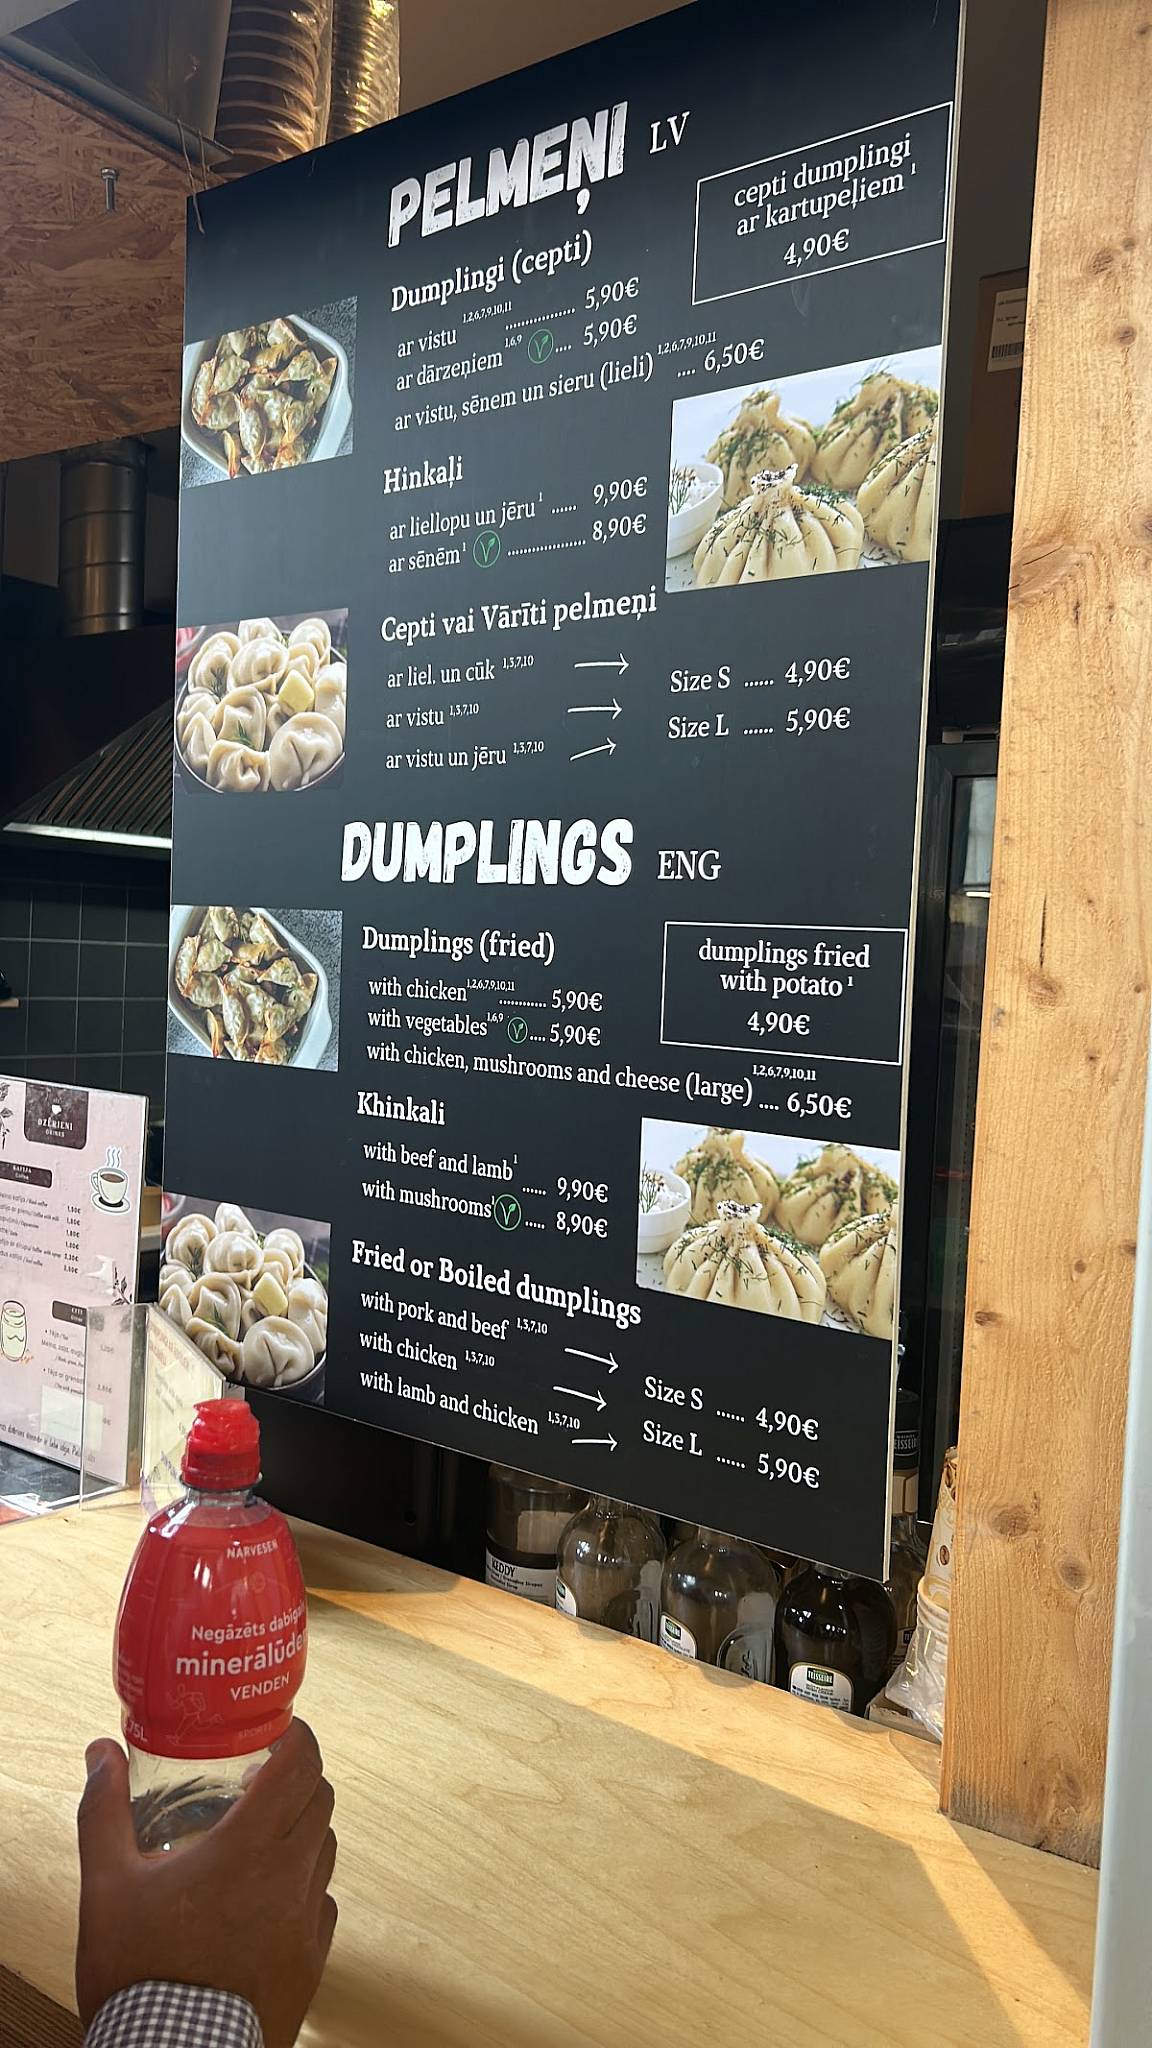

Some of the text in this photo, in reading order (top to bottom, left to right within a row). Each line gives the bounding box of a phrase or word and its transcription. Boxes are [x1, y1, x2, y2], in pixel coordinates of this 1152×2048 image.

[650, 112, 689, 153] LV
[387, 101, 627, 248] PELMEŅI
[735, 133, 911, 207] cepti dumplingi
[737, 215, 759, 235] ar
[765, 172, 905, 228] kartupeļiem
[784, 229, 851, 268] 4,90€
[392, 230, 591, 313] Dumplingi (cepti)
[398, 341, 414, 357] ar
[419, 330, 456, 351] vistu
[585, 277, 638, 311] 5,90€
[397, 374, 413, 390] ar
[417, 353, 502, 385] dārzeņiem
[584, 315, 637, 347] 5,90€
[395, 414, 411, 430] ar
[416, 405, 457, 425] vistu,
[462, 391, 516, 416] sēnem
[523, 385, 543, 402] un
[549, 373, 594, 396] sieru
[601, 352, 653, 390] (lieli)
[705, 339, 764, 373] 6,50€
[384, 456, 462, 494] Hinkaļi
[390, 524, 406, 540] ar
[410, 512, 470, 536] liellopu
[476, 510, 496, 524] un
[500, 501, 535, 528] jēru
[594, 477, 647, 505] 9,90€
[389, 558, 405, 572] ar
[409, 548, 460, 570] sēnēm
[593, 514, 646, 544] 8,90€
[382, 585, 656, 646] Cepti vai Vārīti pelmeņi
[388, 673, 403, 687] ar
[408, 664, 435, 686] liel.
[441, 669, 460, 683] un
[466, 659, 494, 681] cūk
[671, 658, 850, 692] Size S 4,90€
[387, 714, 402, 728] ar
[407, 708, 444, 726] vistu
[669, 707, 850, 738] Size L 5,90€
[386, 755, 402, 768] ar
[406, 749, 443, 767] vistu
[449, 752, 468, 766] un
[472, 746, 506, 771] jēru
[341, 819, 633, 885] DUMPLINGS
[658, 850, 721, 880] ENG
[363, 927, 554, 966] Dumplings (fried)
[699, 938, 870, 971] dumplings fried
[369, 977, 402, 996] with
[407, 978, 467, 1001] chicken
[552, 989, 602, 1012] 5,90€
[720, 969, 767, 991] with
[772, 976, 842, 999] potato
[368, 1008, 401, 1027] with
[406, 1014, 487, 1036] vegetables
[550, 1023, 600, 1046] 5,90€
[748, 1012, 810, 1035] 4,90€
[367, 1042, 400, 1062] with
[404, 1045, 468, 1073] chicken,
[473, 1054, 572, 1080] mushrooms
[577, 1064, 610, 1084] and
[616, 1068, 680, 1092] cheese
[686, 1072, 752, 1106] (large)
[788, 1093, 851, 1118] 6,50€
[357, 1092, 444, 1125] Khinkali
[364, 1142, 396, 1162] with
[401, 1147, 436, 1168] beef
[439, 1154, 467, 1173] and
[472, 1156, 512, 1180] lamb
[558, 1177, 608, 1203] 9,90€
[362, 1180, 395, 1200] with
[400, 1188, 493, 1217] mushrooms
[557, 1212, 607, 1238] 8,90€
[352, 1240, 642, 1329] Fried or Boiled dumplings
[361, 1292, 394, 1312] with
[398, 1302, 434, 1322] pork
[438, 1310, 467, 1330] and
[472, 1316, 509, 1340] beef
[360, 1332, 392, 1353] with
[397, 1339, 457, 1370] chicken
[360, 1371, 393, 1393] with
[398, 1377, 435, 1405] lamb
[440, 1394, 468, 1414] and
[473, 1400, 538, 1434] chicken
[645, 1376, 818, 1440] Size S 4,90€
[644, 1420, 819, 1488] Size L 5,90€
[227, 1539, 279, 1559] NARVESEN
[192, 1622, 265, 1644] Negāzēts
[230, 1671, 290, 1701] VENDEN
